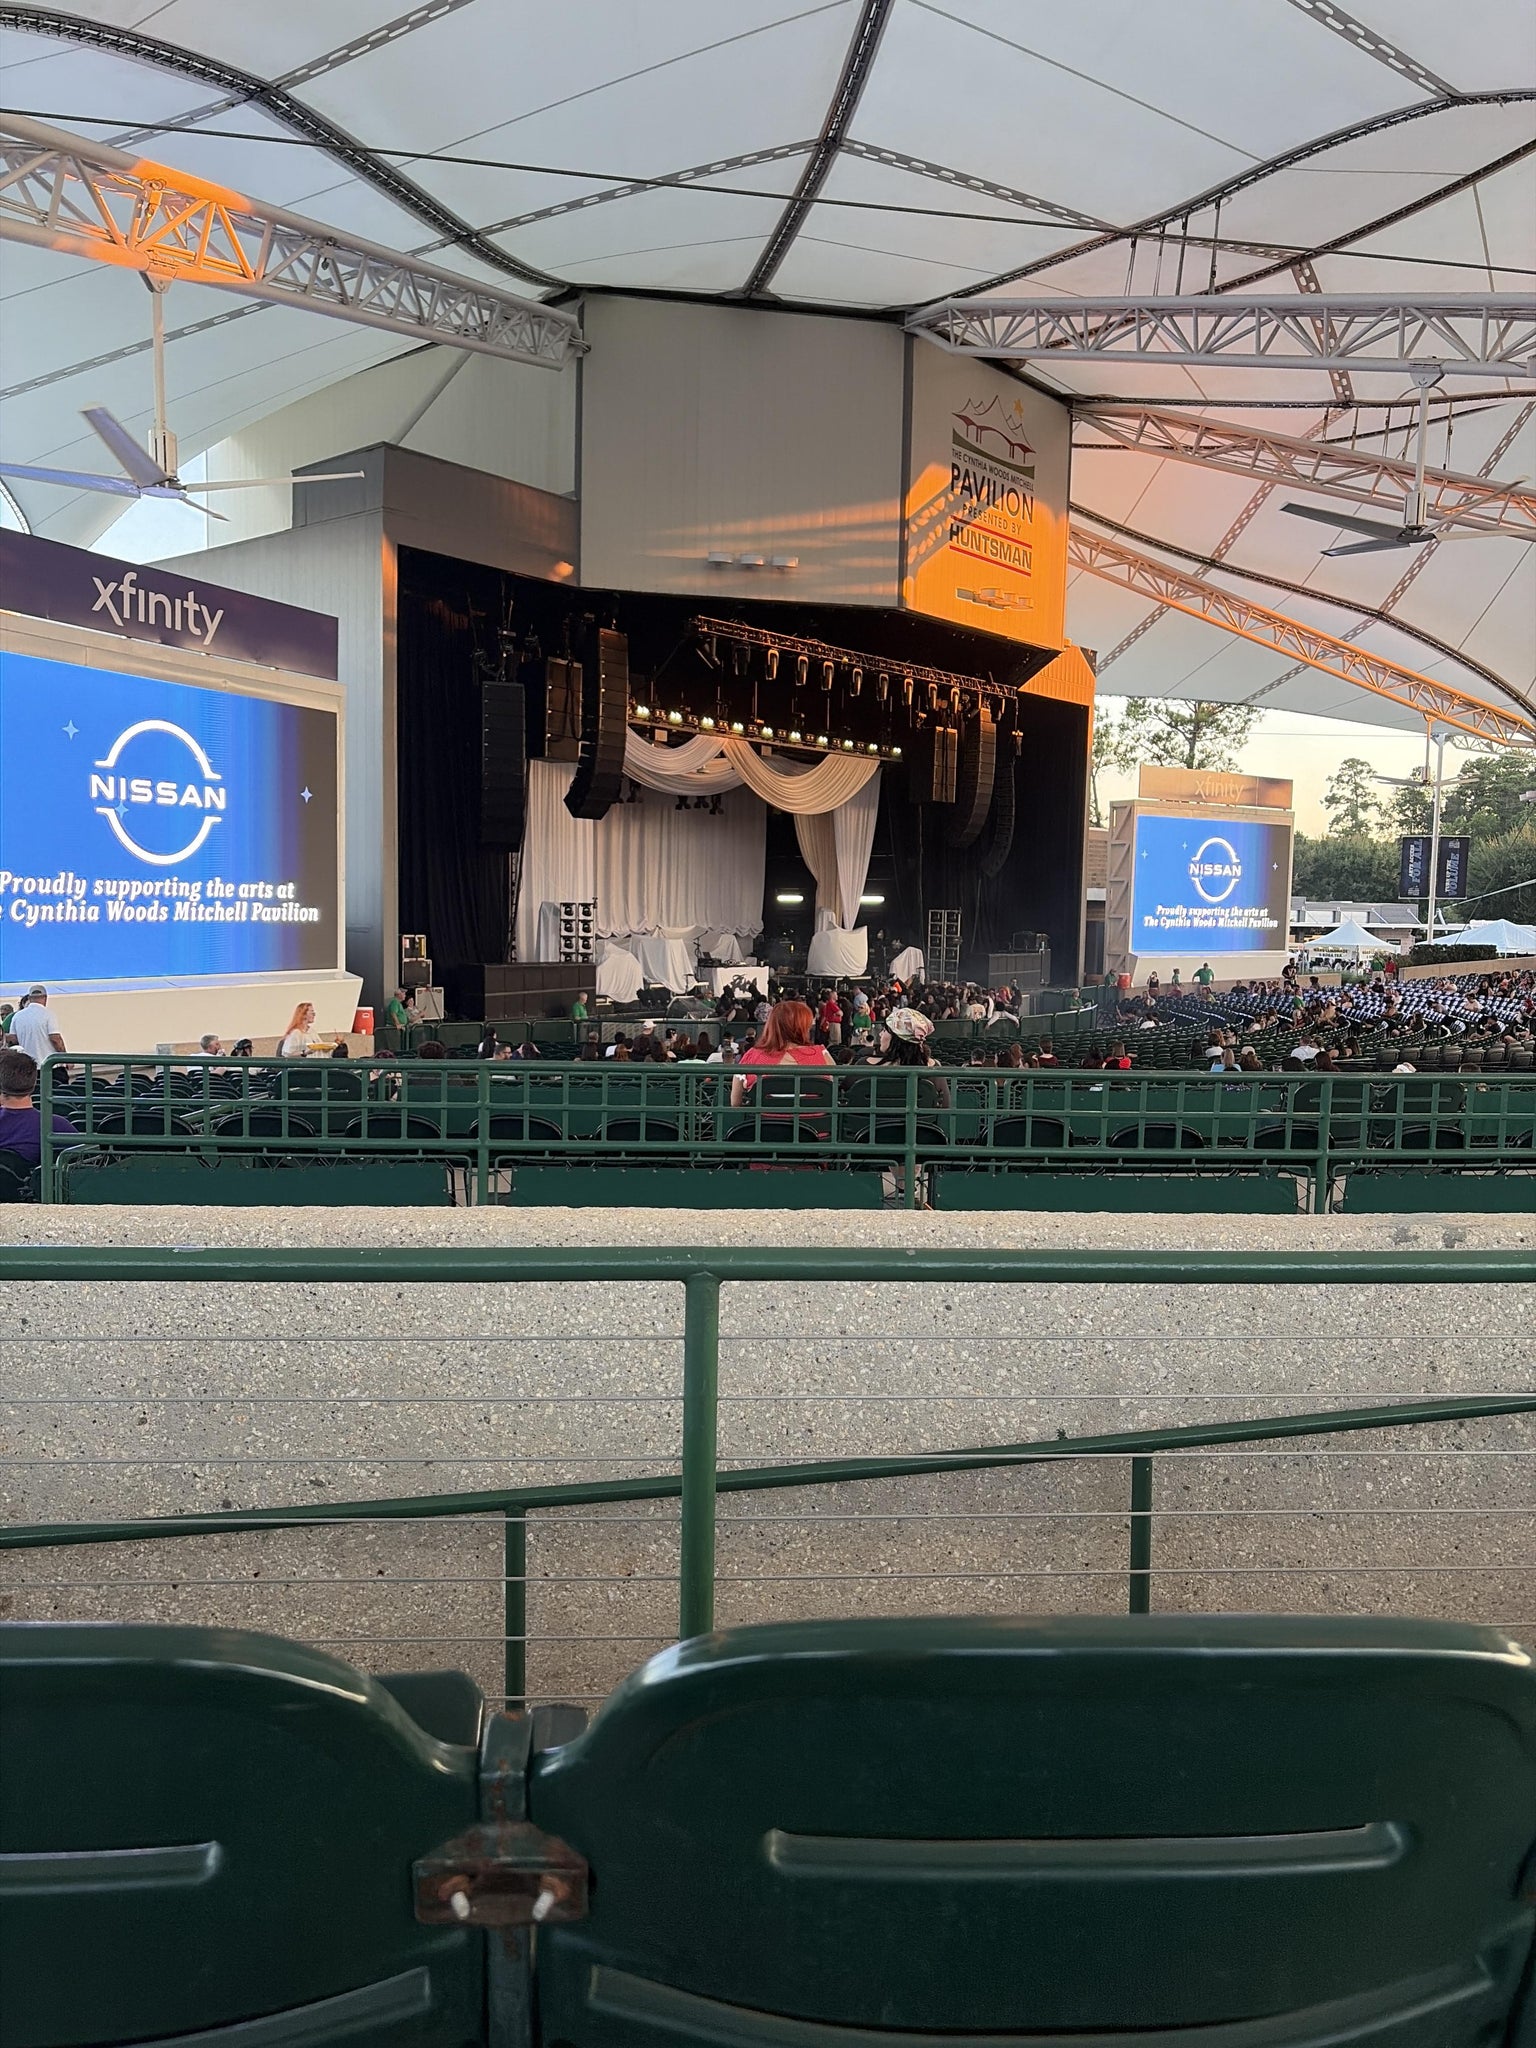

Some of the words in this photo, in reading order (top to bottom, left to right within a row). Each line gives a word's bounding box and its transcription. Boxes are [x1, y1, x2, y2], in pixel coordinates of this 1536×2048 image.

[952, 448, 962, 461] THE
[963, 454, 988, 471] CYNTHIA
[989, 466, 1010, 481] WOODS
[1011, 475, 1034, 492] MITCHELL
[950, 462, 1034, 524] PAVILION
[963, 504, 1007, 530] PRESENTED
[1012, 522, 1022, 535] BY
[949, 523, 1032, 569] HUNTSMAN
[91, 571, 224, 645] xfinity
[90, 774, 227, 810] NISSAN
[1195, 776, 1244, 802] xfinity
[1414, 839, 1423, 860] ALL
[0, 870, 87, 900] Proudly
[93, 876, 202, 901] supporting
[206, 877, 234, 899] the
[238, 881, 274, 899] arts
[276, 882, 295, 900] at
[1189, 863, 1242, 877] NISSAN
[1412, 861, 1422, 883] FOR
[1448, 852, 1460, 897] VOLUME
[10, 899, 100, 927] Cynthia
[106, 901, 169, 922] Woods
[173, 901, 248, 922] Mitchell
[251, 902, 319, 923] Pavilion
[1143, 916, 1159, 927] The
[1160, 916, 1191, 929] Cynthia
[1193, 917, 1216, 928] Woods
[1217, 917, 1248, 928] Mitchell
[1248, 917, 1279, 929] Pavilion
[1156, 904, 1187, 917] Proudly
[1188, 906, 1230, 919] supporting
[1231, 905, 1243, 916] the
[1243, 907, 1259, 917] arts
[1260, 907, 1268, 917] at
